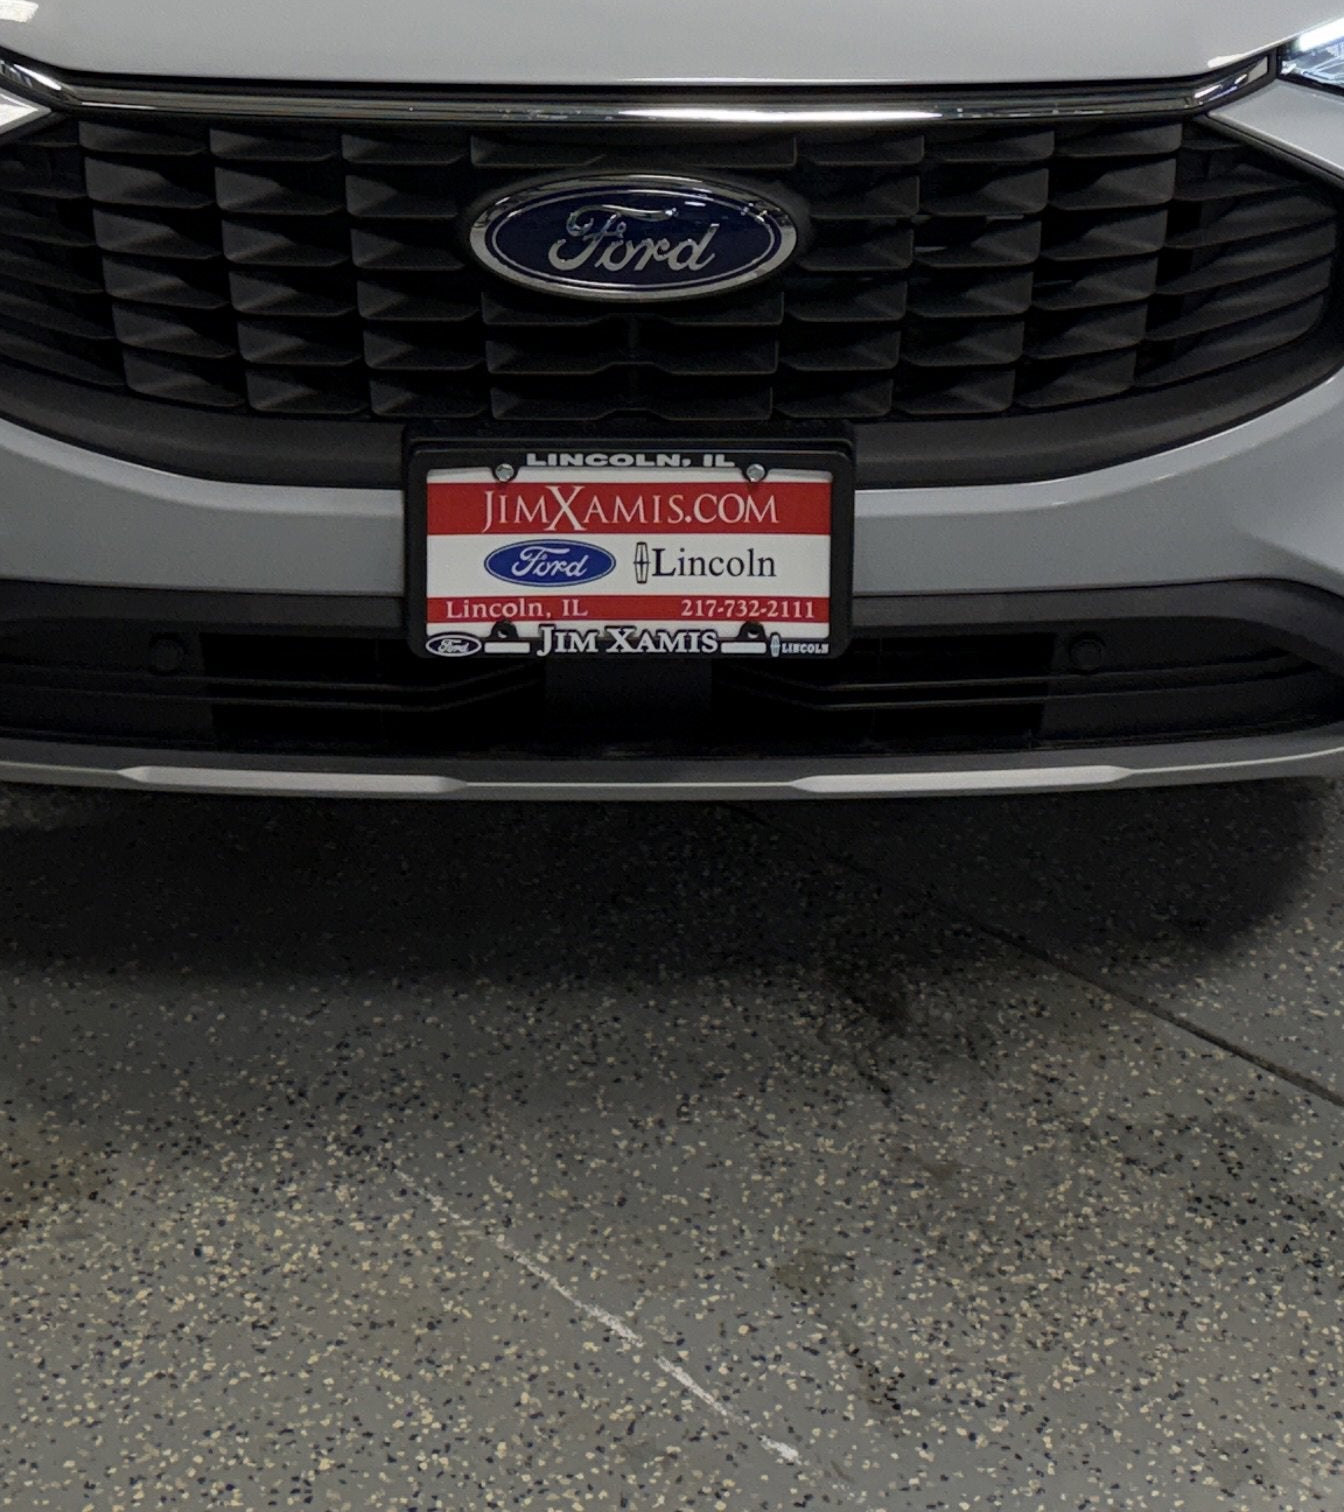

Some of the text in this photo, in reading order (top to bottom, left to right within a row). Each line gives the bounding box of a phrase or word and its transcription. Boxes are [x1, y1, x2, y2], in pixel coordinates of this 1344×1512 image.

[548, 203, 720, 272] Ford
[526, 453, 736, 469] LINCOLN, IL
[511, 545, 590, 578] Ford
[651, 547, 777, 577] Lincoln
[446, 598, 589, 619] Lincoln, IL
[681, 599, 815, 618] 217-732-2111
[437, 639, 469, 654] Ford
[537, 625, 719, 656] JIM XAMIS
[781, 642, 830, 655] LINCOLN
